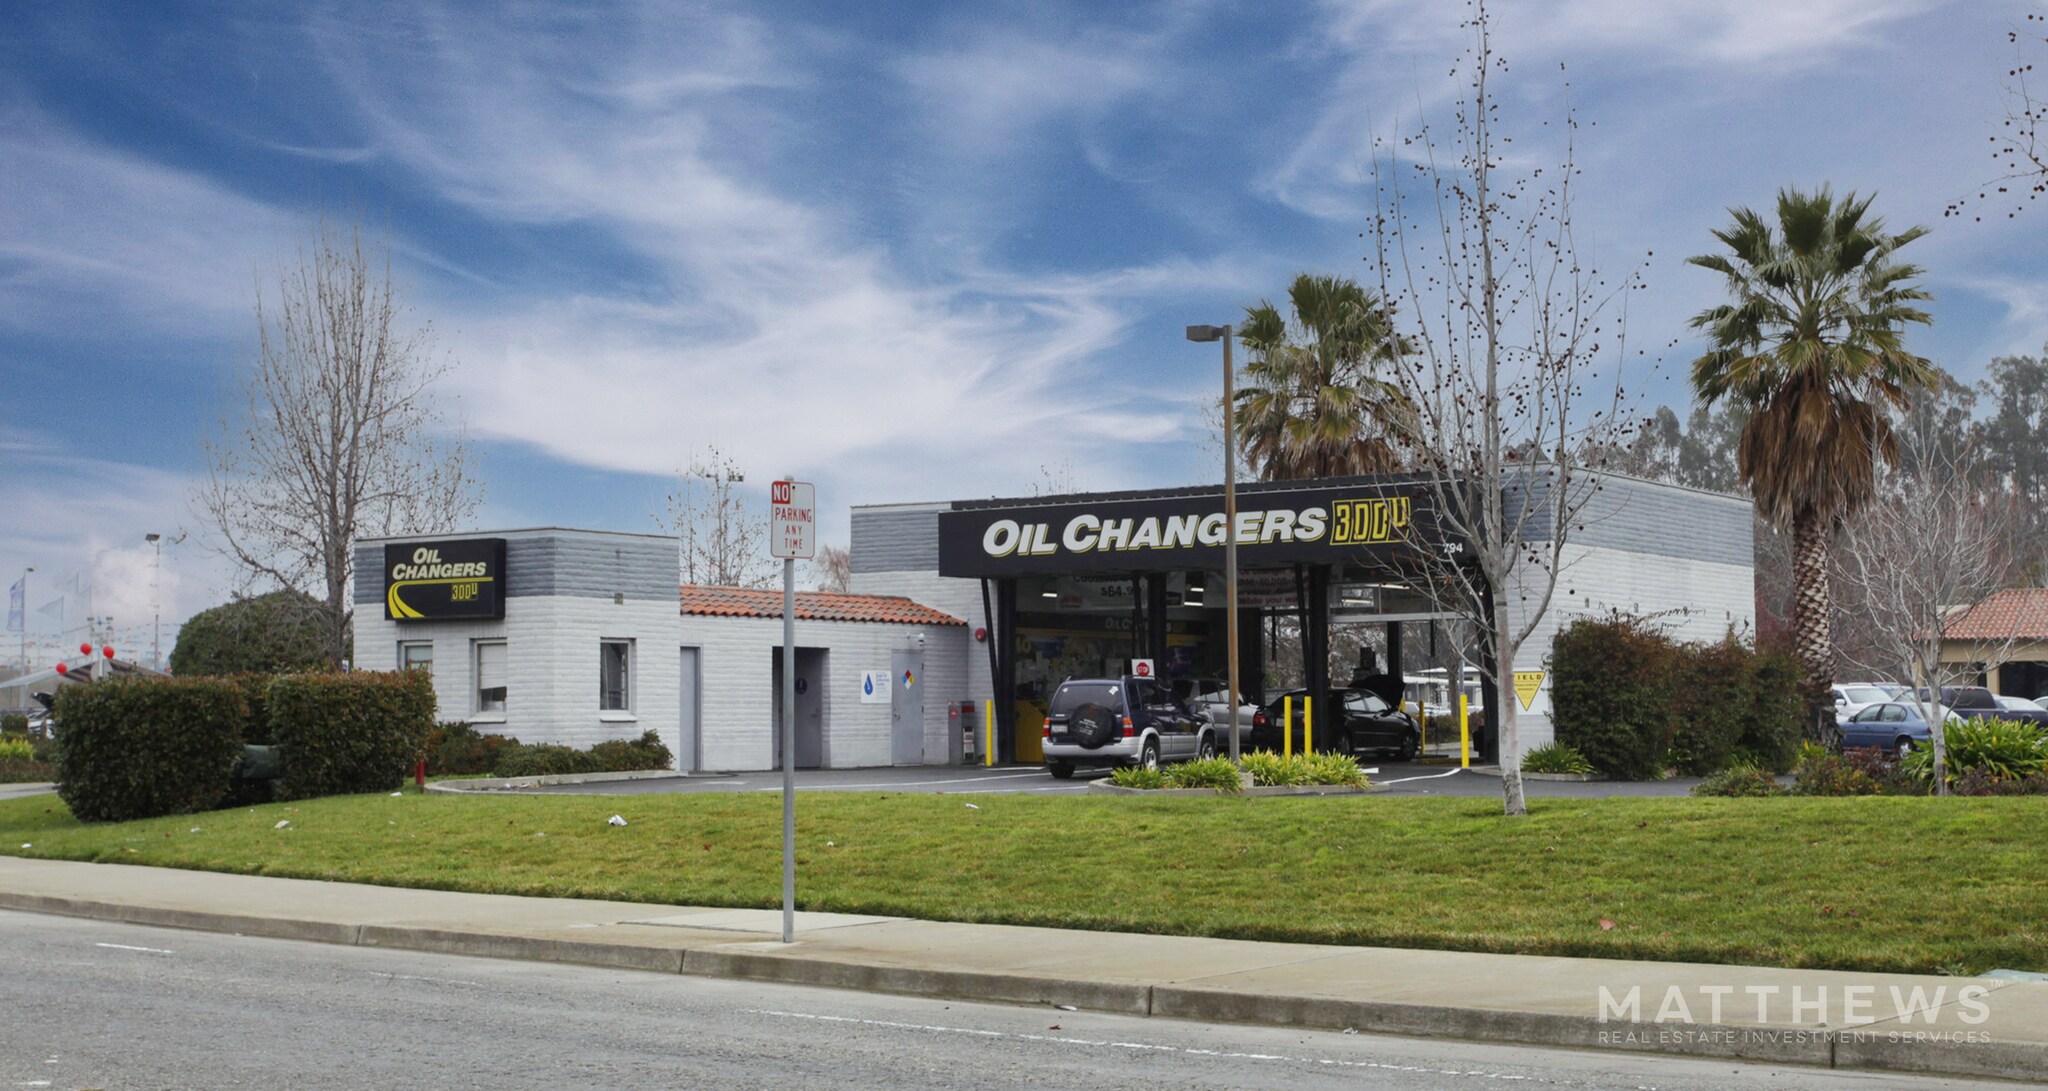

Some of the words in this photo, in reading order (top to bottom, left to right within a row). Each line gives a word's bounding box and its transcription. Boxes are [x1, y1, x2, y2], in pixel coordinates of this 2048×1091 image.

[773, 484, 789, 502] NO
[775, 507, 812, 523] PARKING
[785, 525, 802, 535] ANY
[982, 519, 1058, 558] OIL
[1062, 507, 1329, 553] CHANGERS
[785, 538, 803, 549] TIME
[413, 547, 442, 564] OIL
[392, 562, 487, 580] CHANGERS
